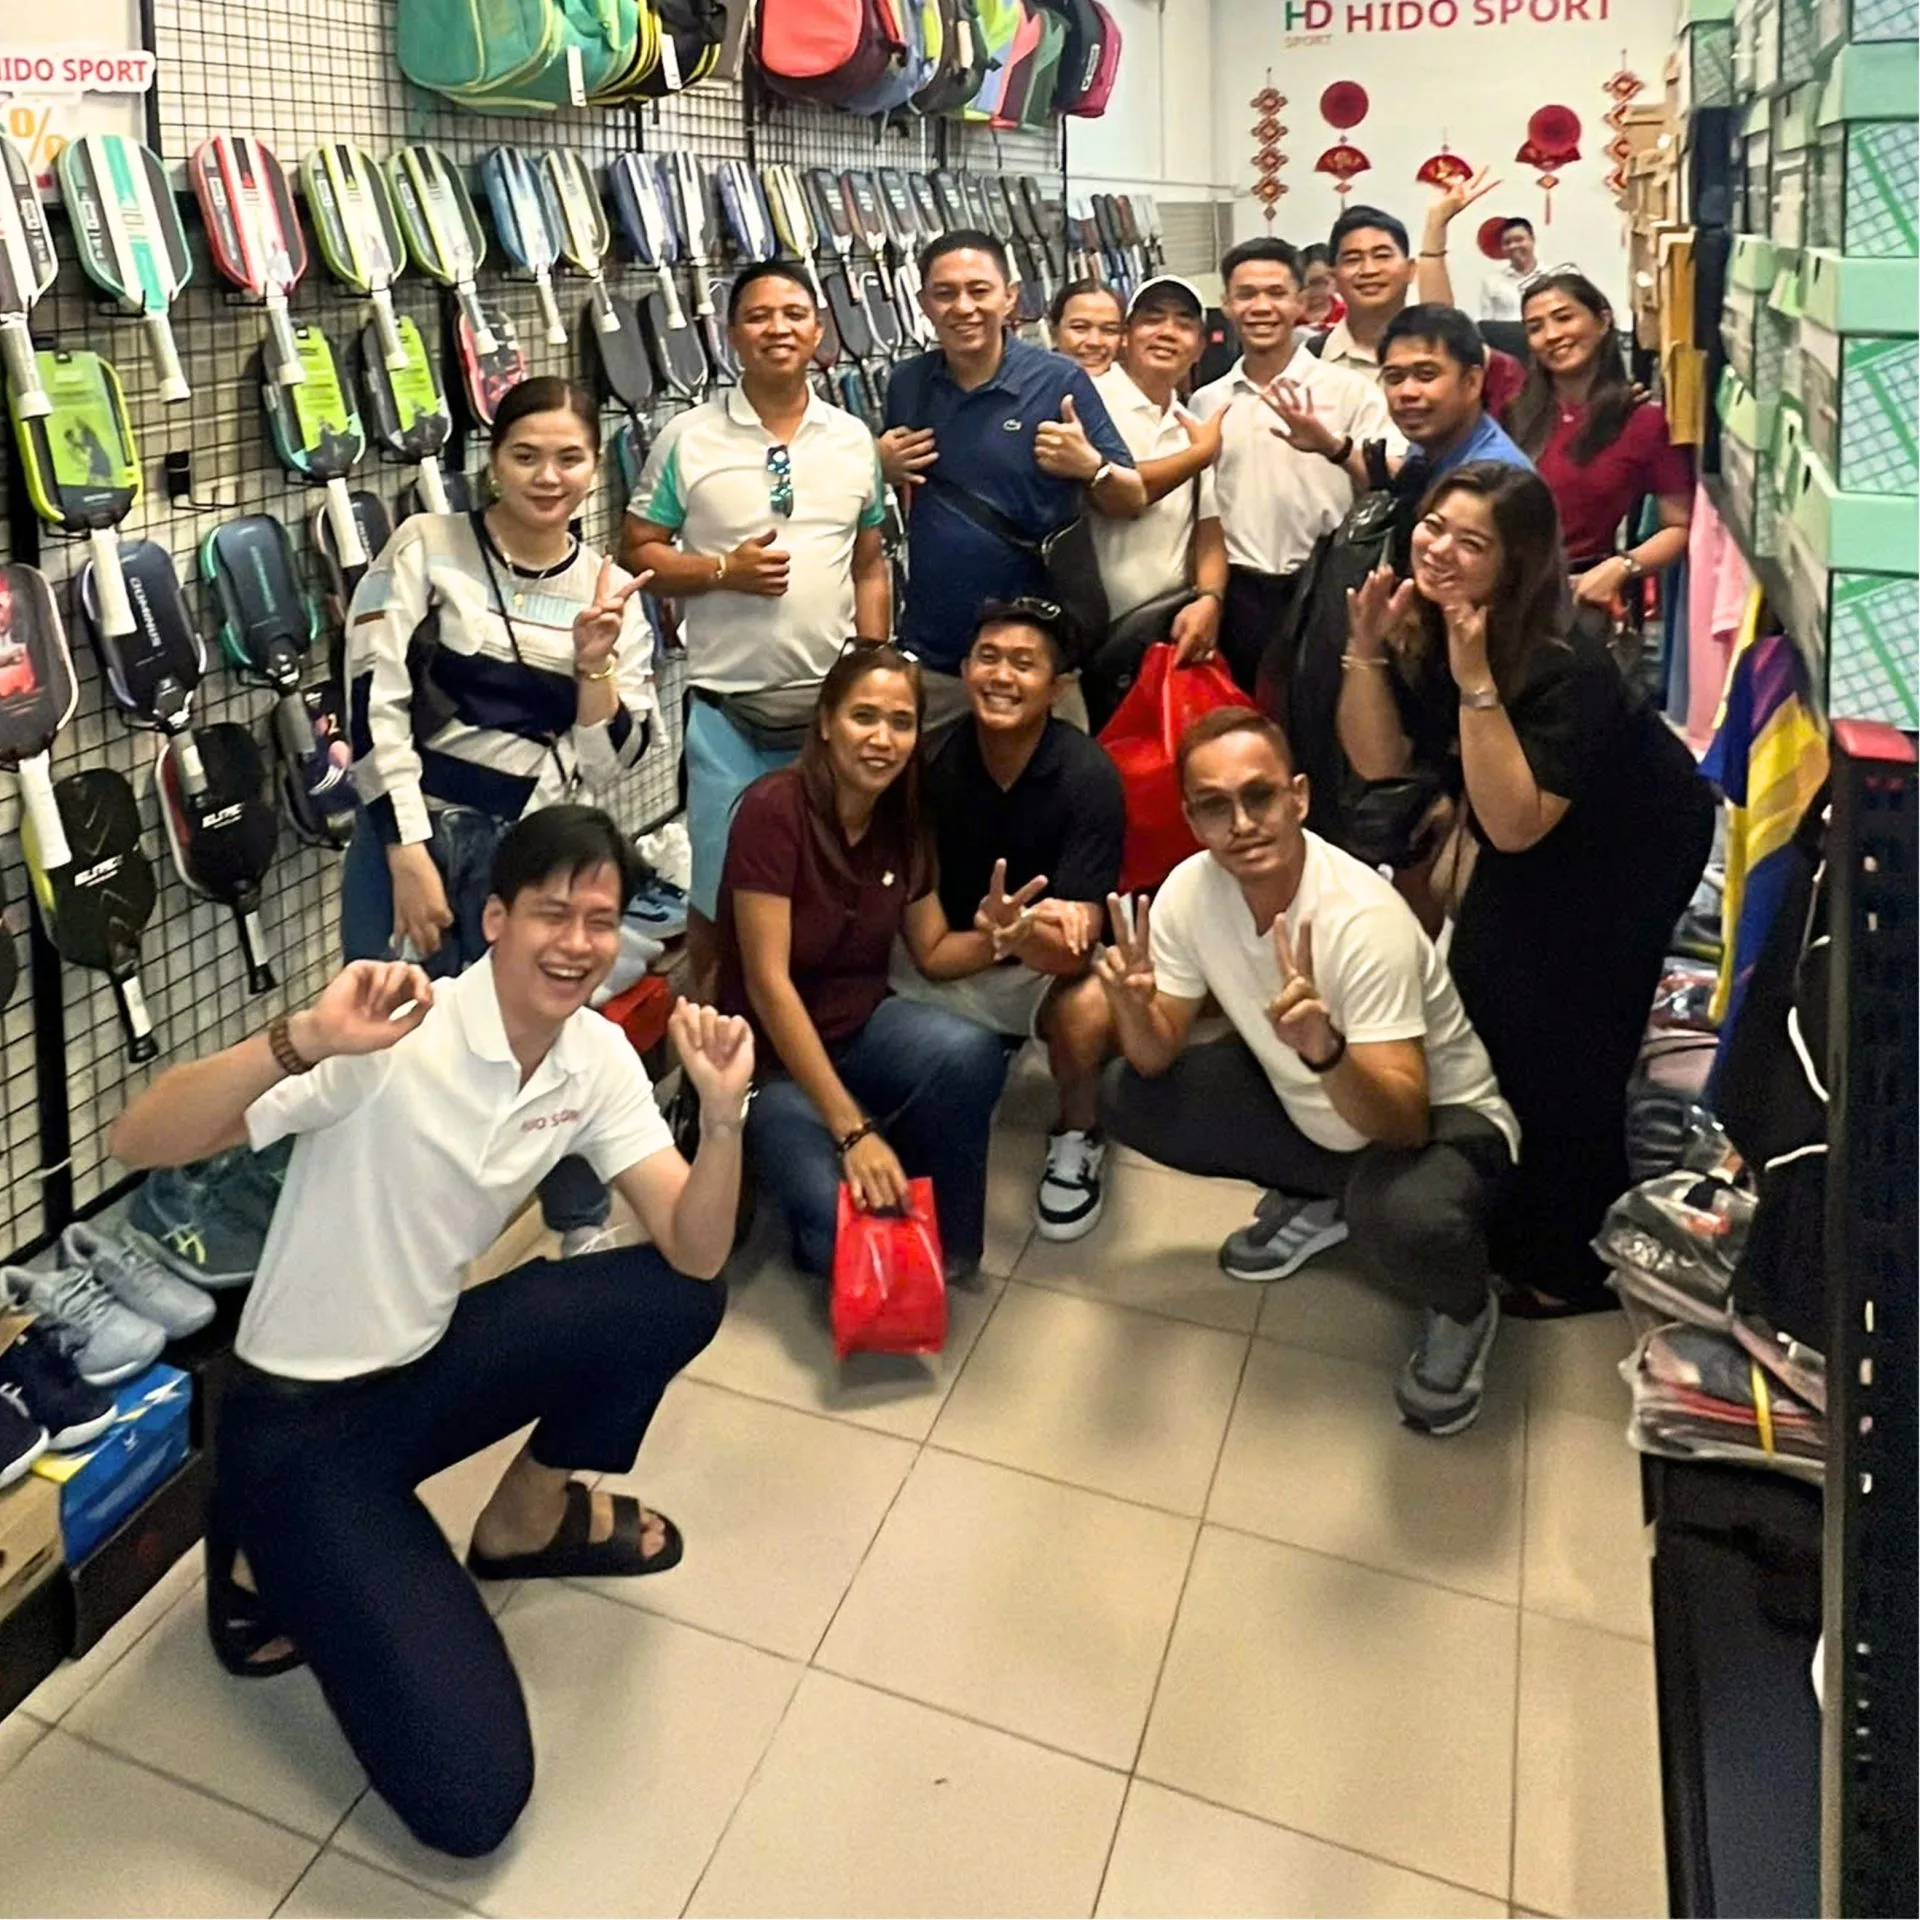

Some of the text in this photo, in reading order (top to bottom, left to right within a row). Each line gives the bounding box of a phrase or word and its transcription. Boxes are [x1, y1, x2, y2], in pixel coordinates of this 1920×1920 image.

[1285, 0, 1333, 31] HD
[1346, 0, 1458, 33] HIDO
[0, 57, 148, 82] IDO SPORT
